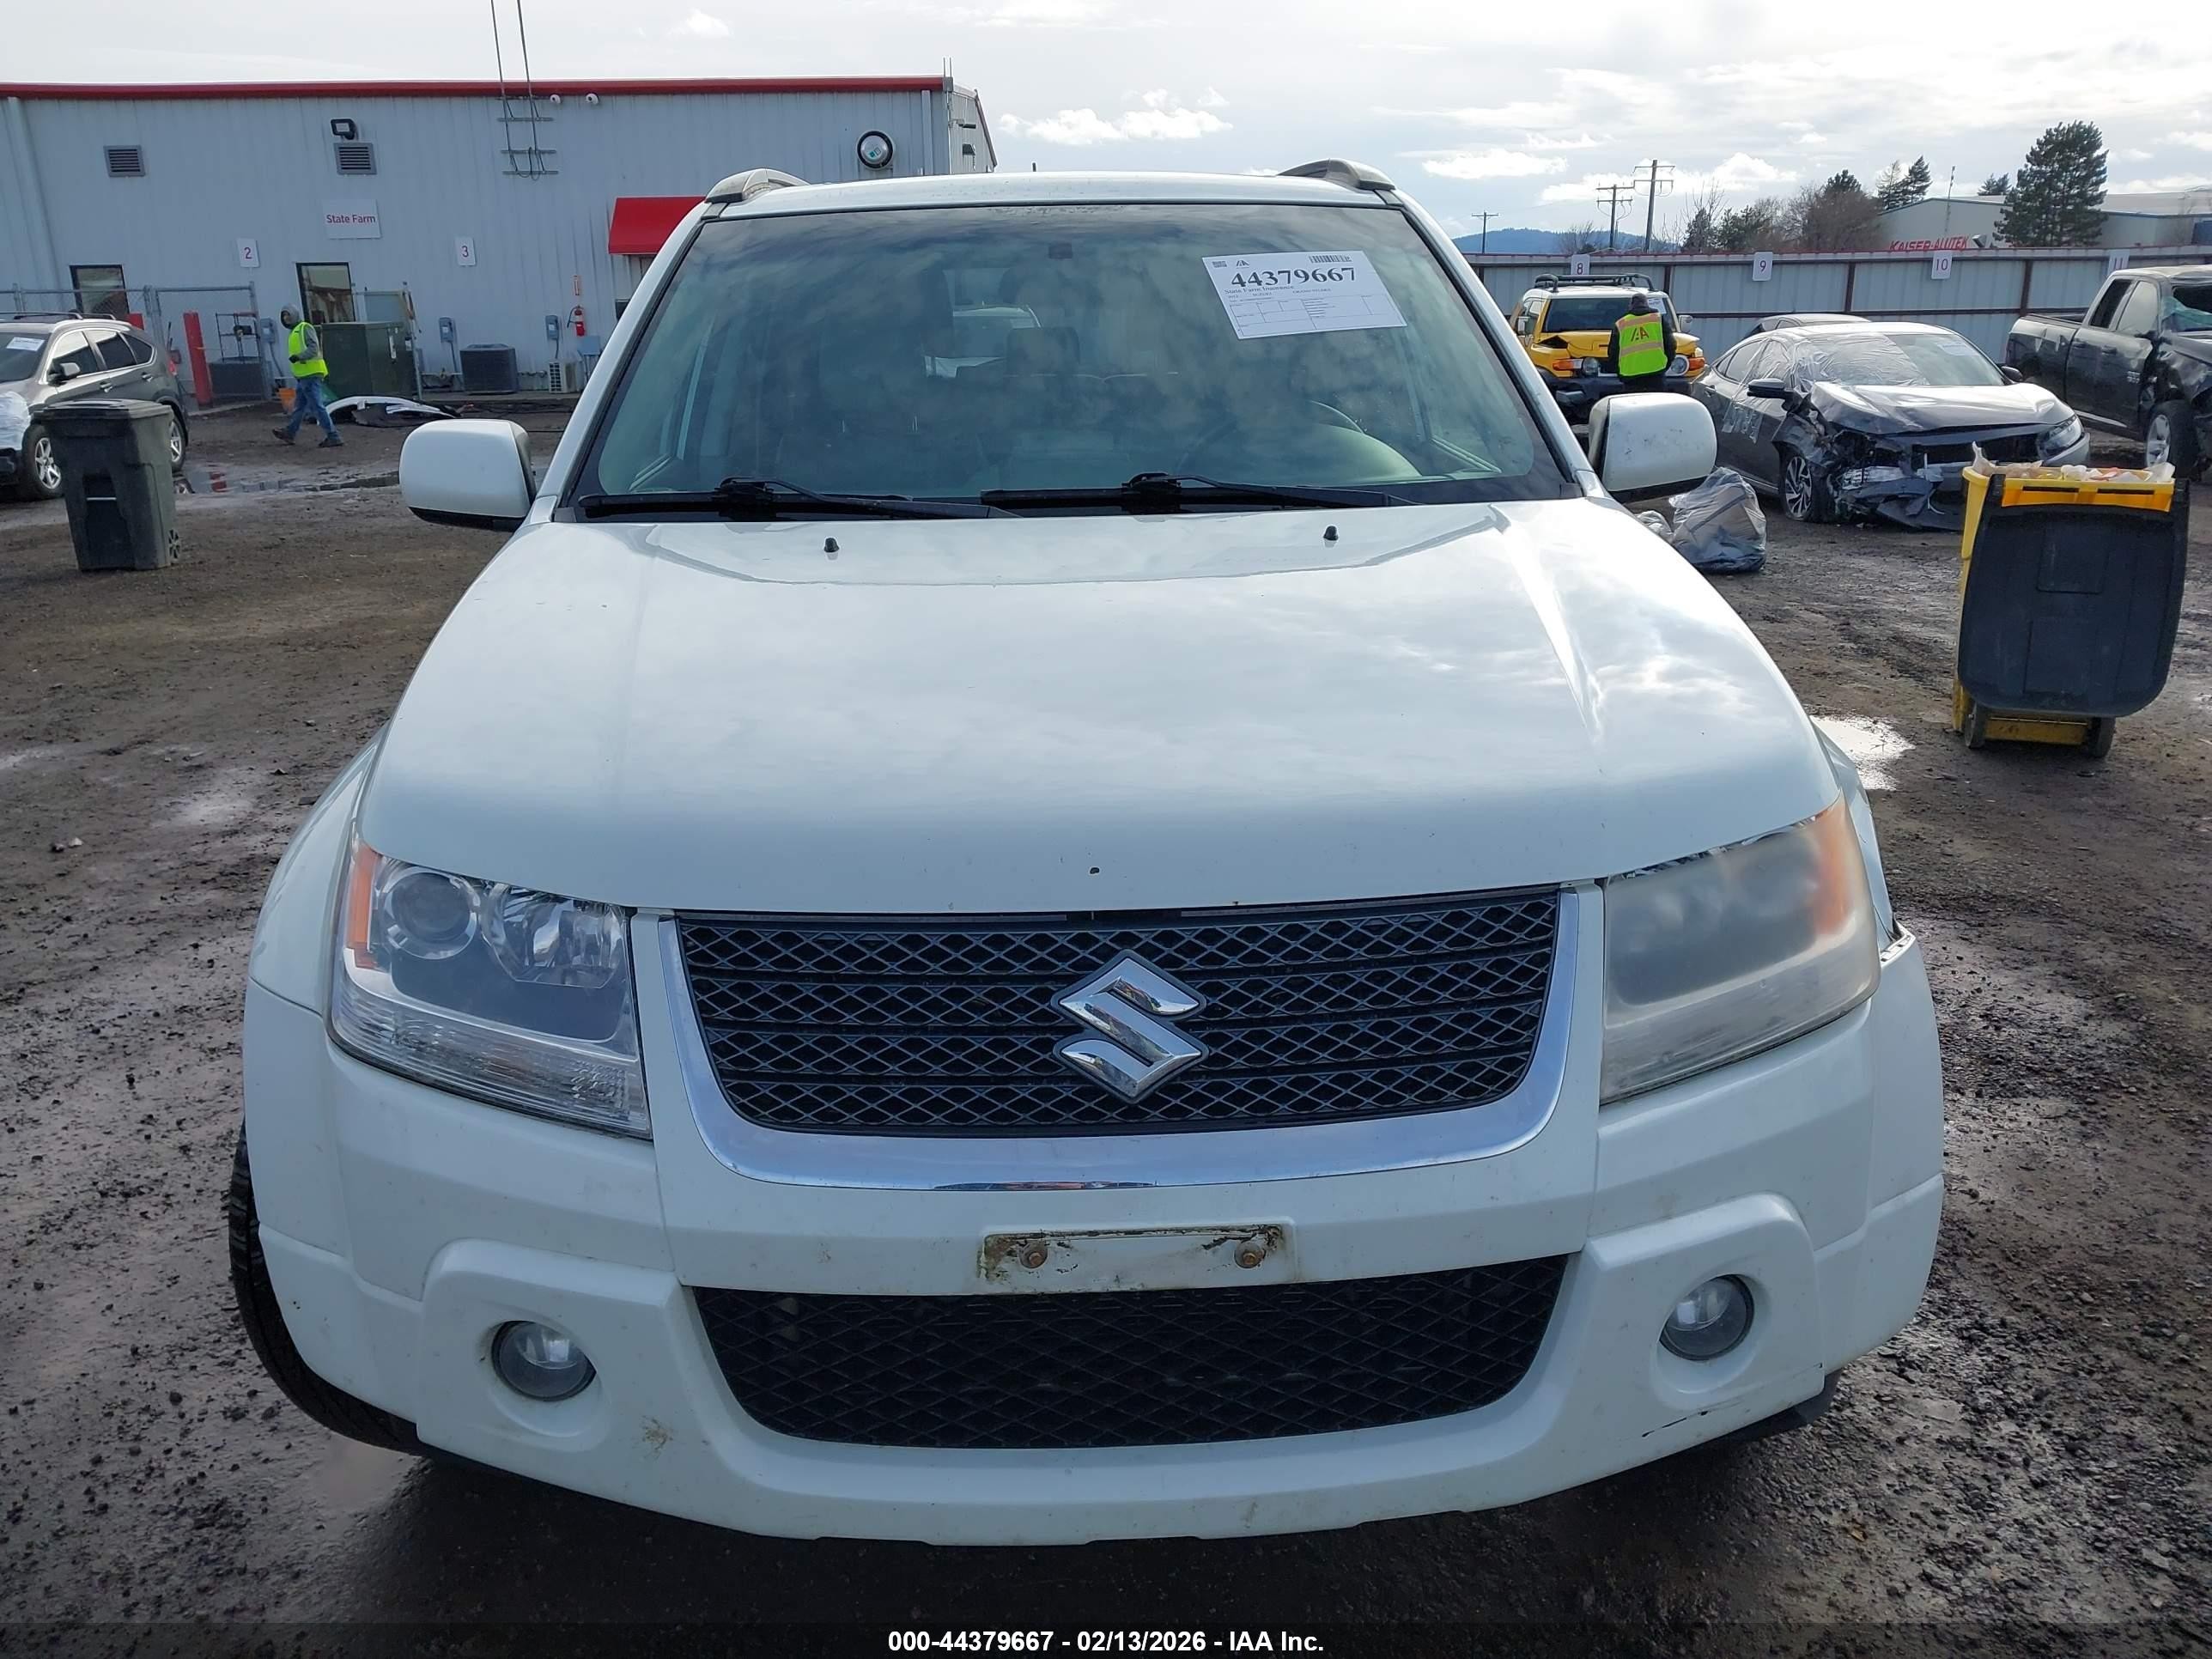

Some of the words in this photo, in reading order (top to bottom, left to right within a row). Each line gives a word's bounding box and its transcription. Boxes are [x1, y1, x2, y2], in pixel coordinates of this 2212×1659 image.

[326, 214, 350, 224] State
[352, 214, 376, 224] Farm
[244, 246, 252, 259] 2
[461, 246, 469, 258] 3
[1576, 262, 1584, 276] 8
[1759, 259, 1767, 273] 9
[1936, 258, 1948, 271] 10
[1231, 267, 1355, 288] 44379667
